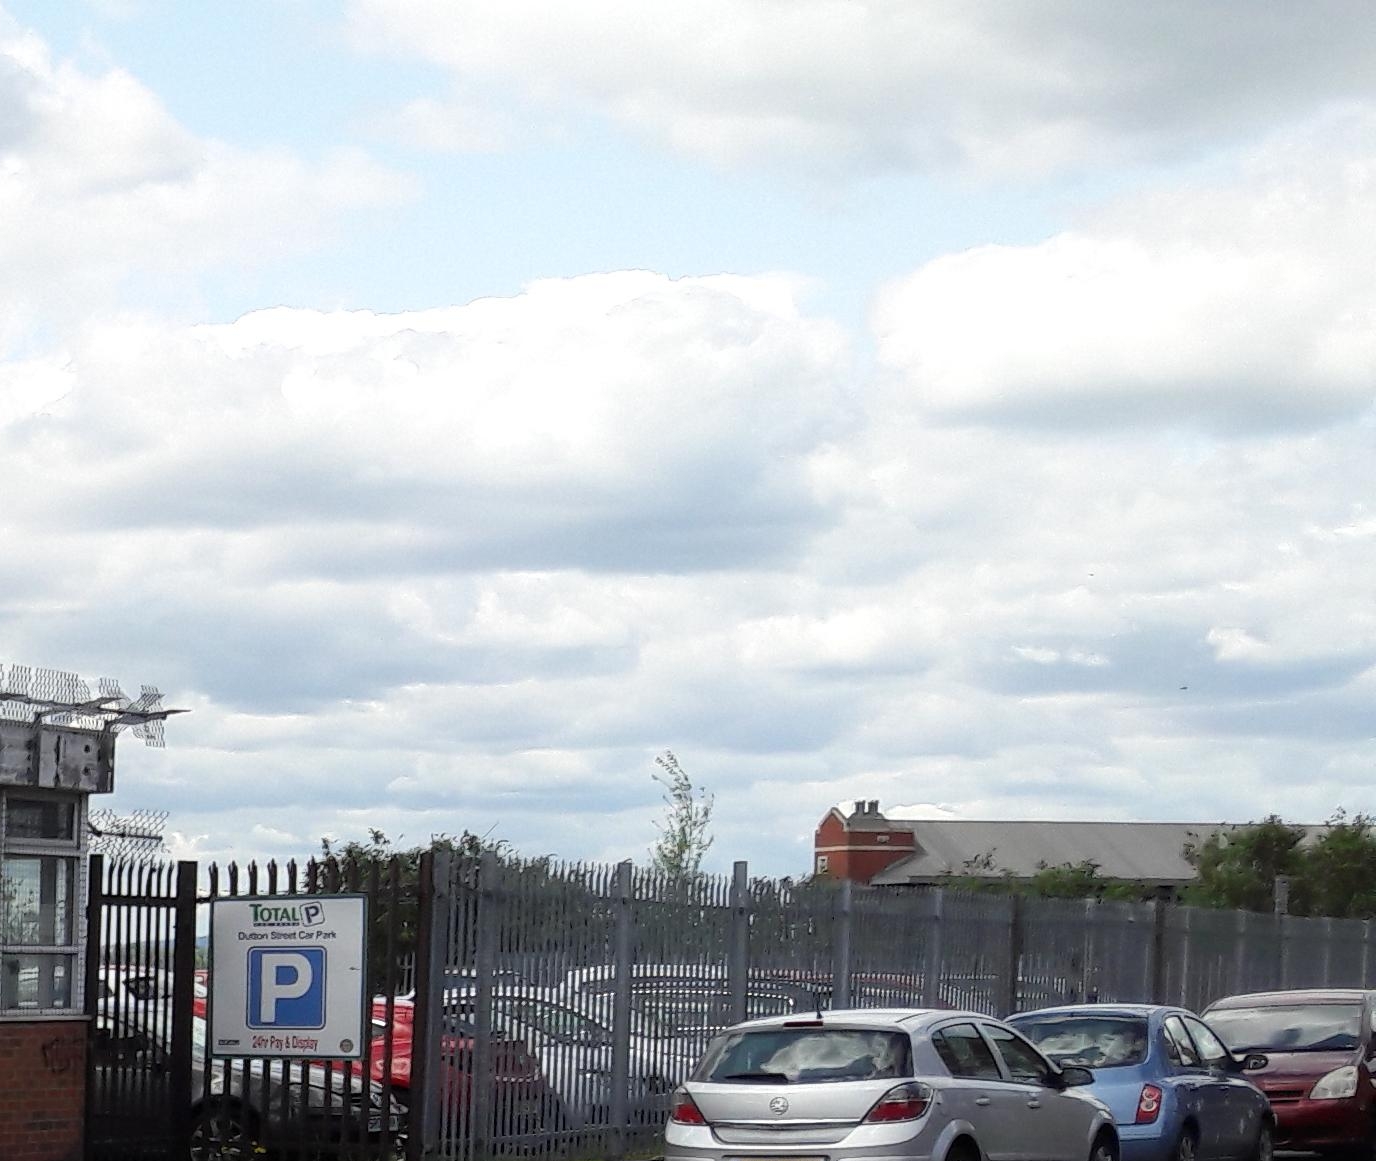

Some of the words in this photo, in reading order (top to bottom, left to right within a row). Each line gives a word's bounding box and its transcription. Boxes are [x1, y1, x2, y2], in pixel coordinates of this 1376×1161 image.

[270, 931, 297, 940] Street
[298, 930, 314, 940] Car
[316, 930, 337, 940] Park
[260, 953, 313, 1024] P
[270, 1035, 284, 1051] Pay
[292, 1035, 319, 1052] Display
